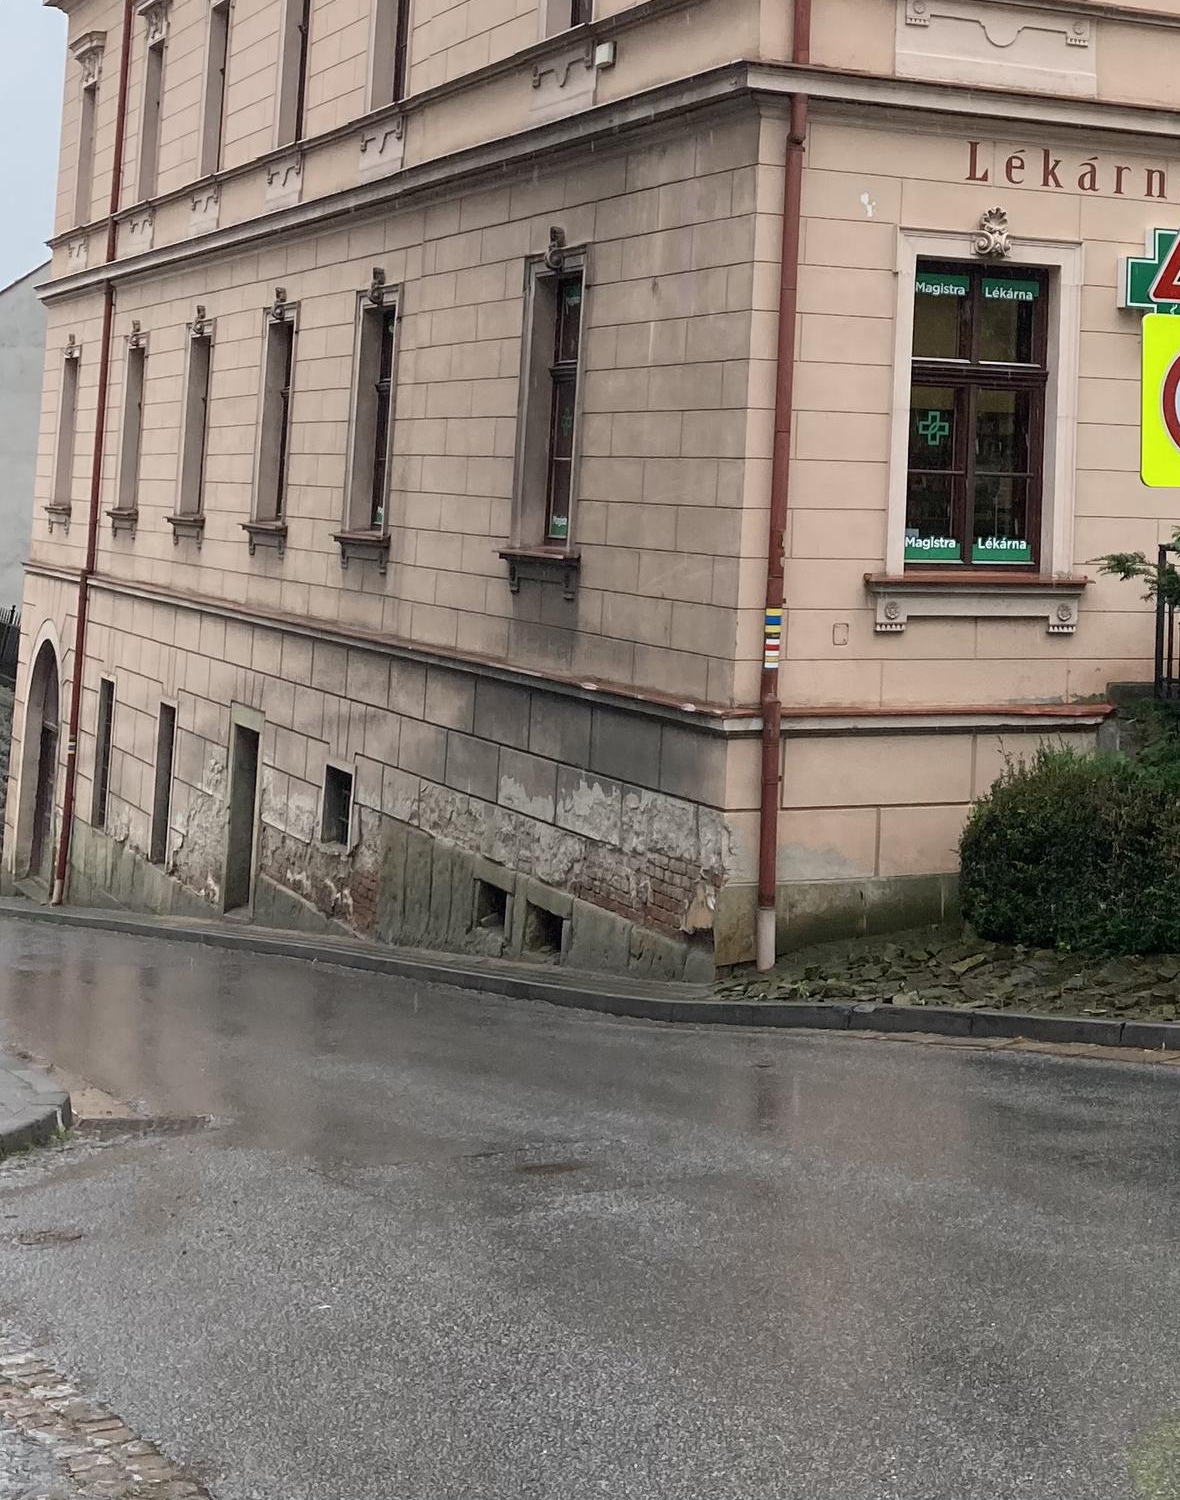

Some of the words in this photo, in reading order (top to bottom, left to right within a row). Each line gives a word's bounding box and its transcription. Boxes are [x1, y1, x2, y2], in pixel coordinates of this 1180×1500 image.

[915, 281, 966, 297] Magistra
[984, 286, 1034, 300] Lékárna
[905, 536, 956, 550] Magistra
[978, 536, 1028, 550] Lékárna
